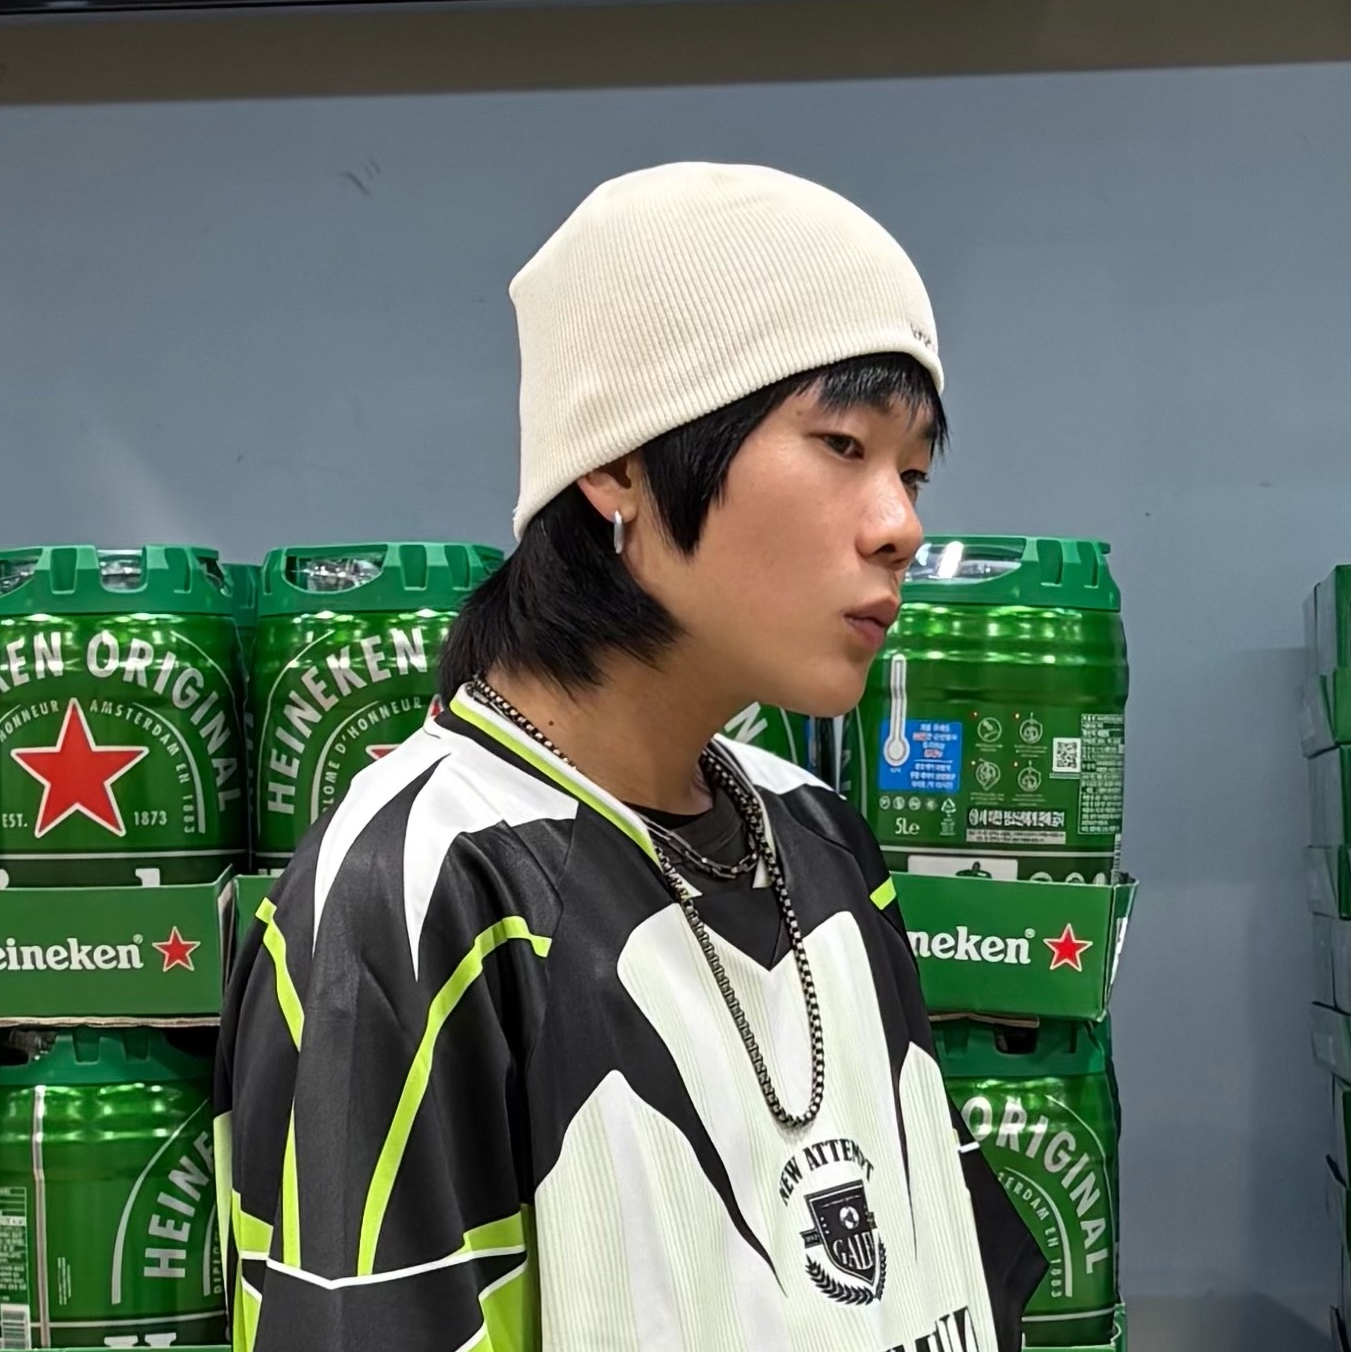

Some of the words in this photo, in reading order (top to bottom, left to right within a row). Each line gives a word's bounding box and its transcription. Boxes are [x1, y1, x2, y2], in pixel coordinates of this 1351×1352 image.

[86, 630, 243, 814] ORIGINAL
[89, 700, 180, 757] AMSTERDAM
[268, 628, 427, 815] HEINEKEN
[1, 812, 27, 828] EST.
[134, 810, 167, 826] 1873
[961, 1095, 1110, 1274] ORIGINAL
